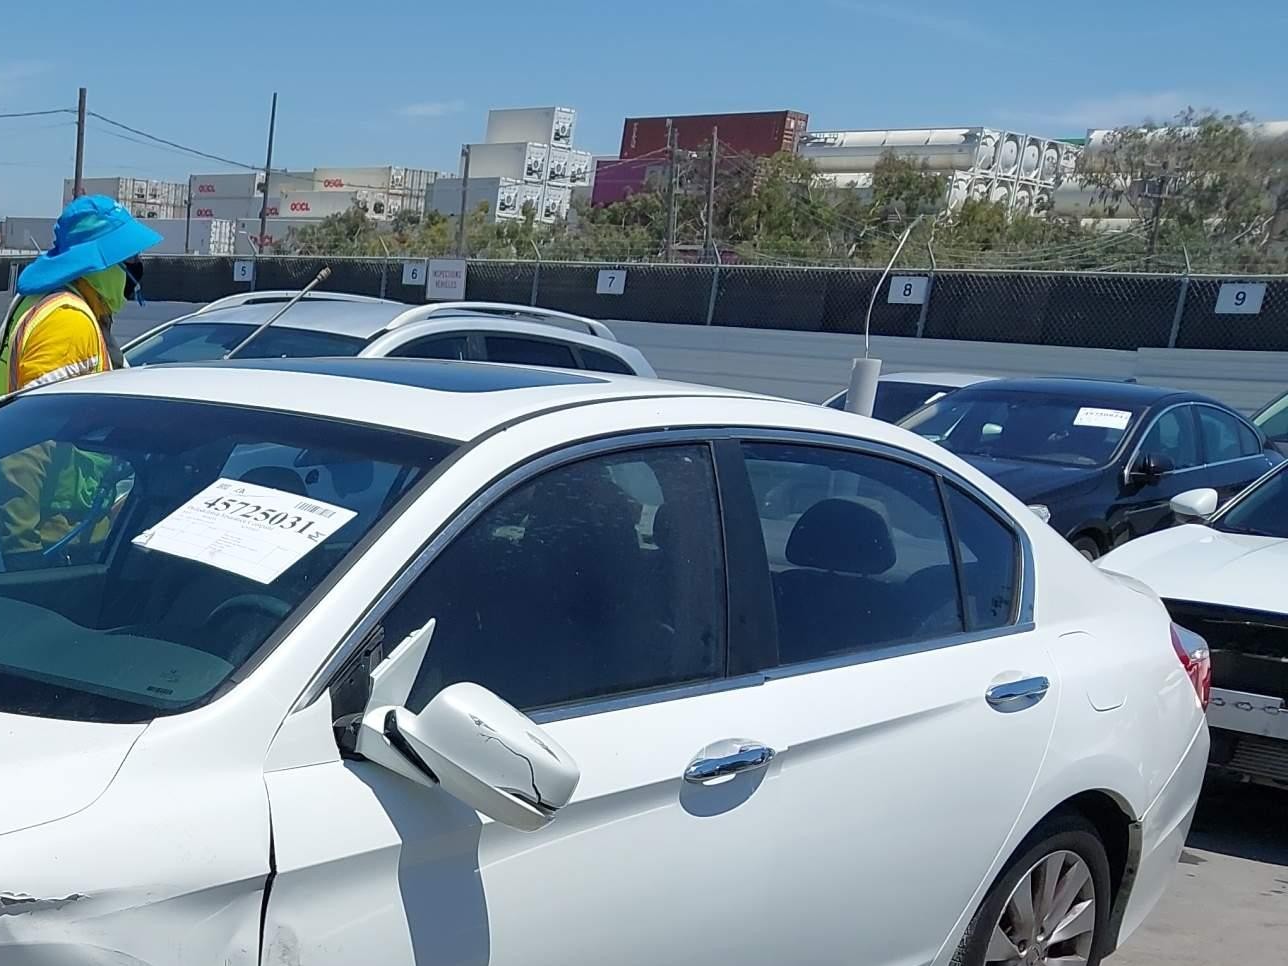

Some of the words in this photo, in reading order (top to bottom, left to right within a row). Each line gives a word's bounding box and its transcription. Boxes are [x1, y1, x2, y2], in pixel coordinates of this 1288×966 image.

[290, 202, 311, 212] OOCL
[241, 266, 247, 277] 5
[411, 268, 418, 280] 6
[608, 276, 616, 288] 7
[903, 283, 913, 297] 8
[1234, 290, 1247, 306] 9
[203, 496, 315, 535] 45725031
